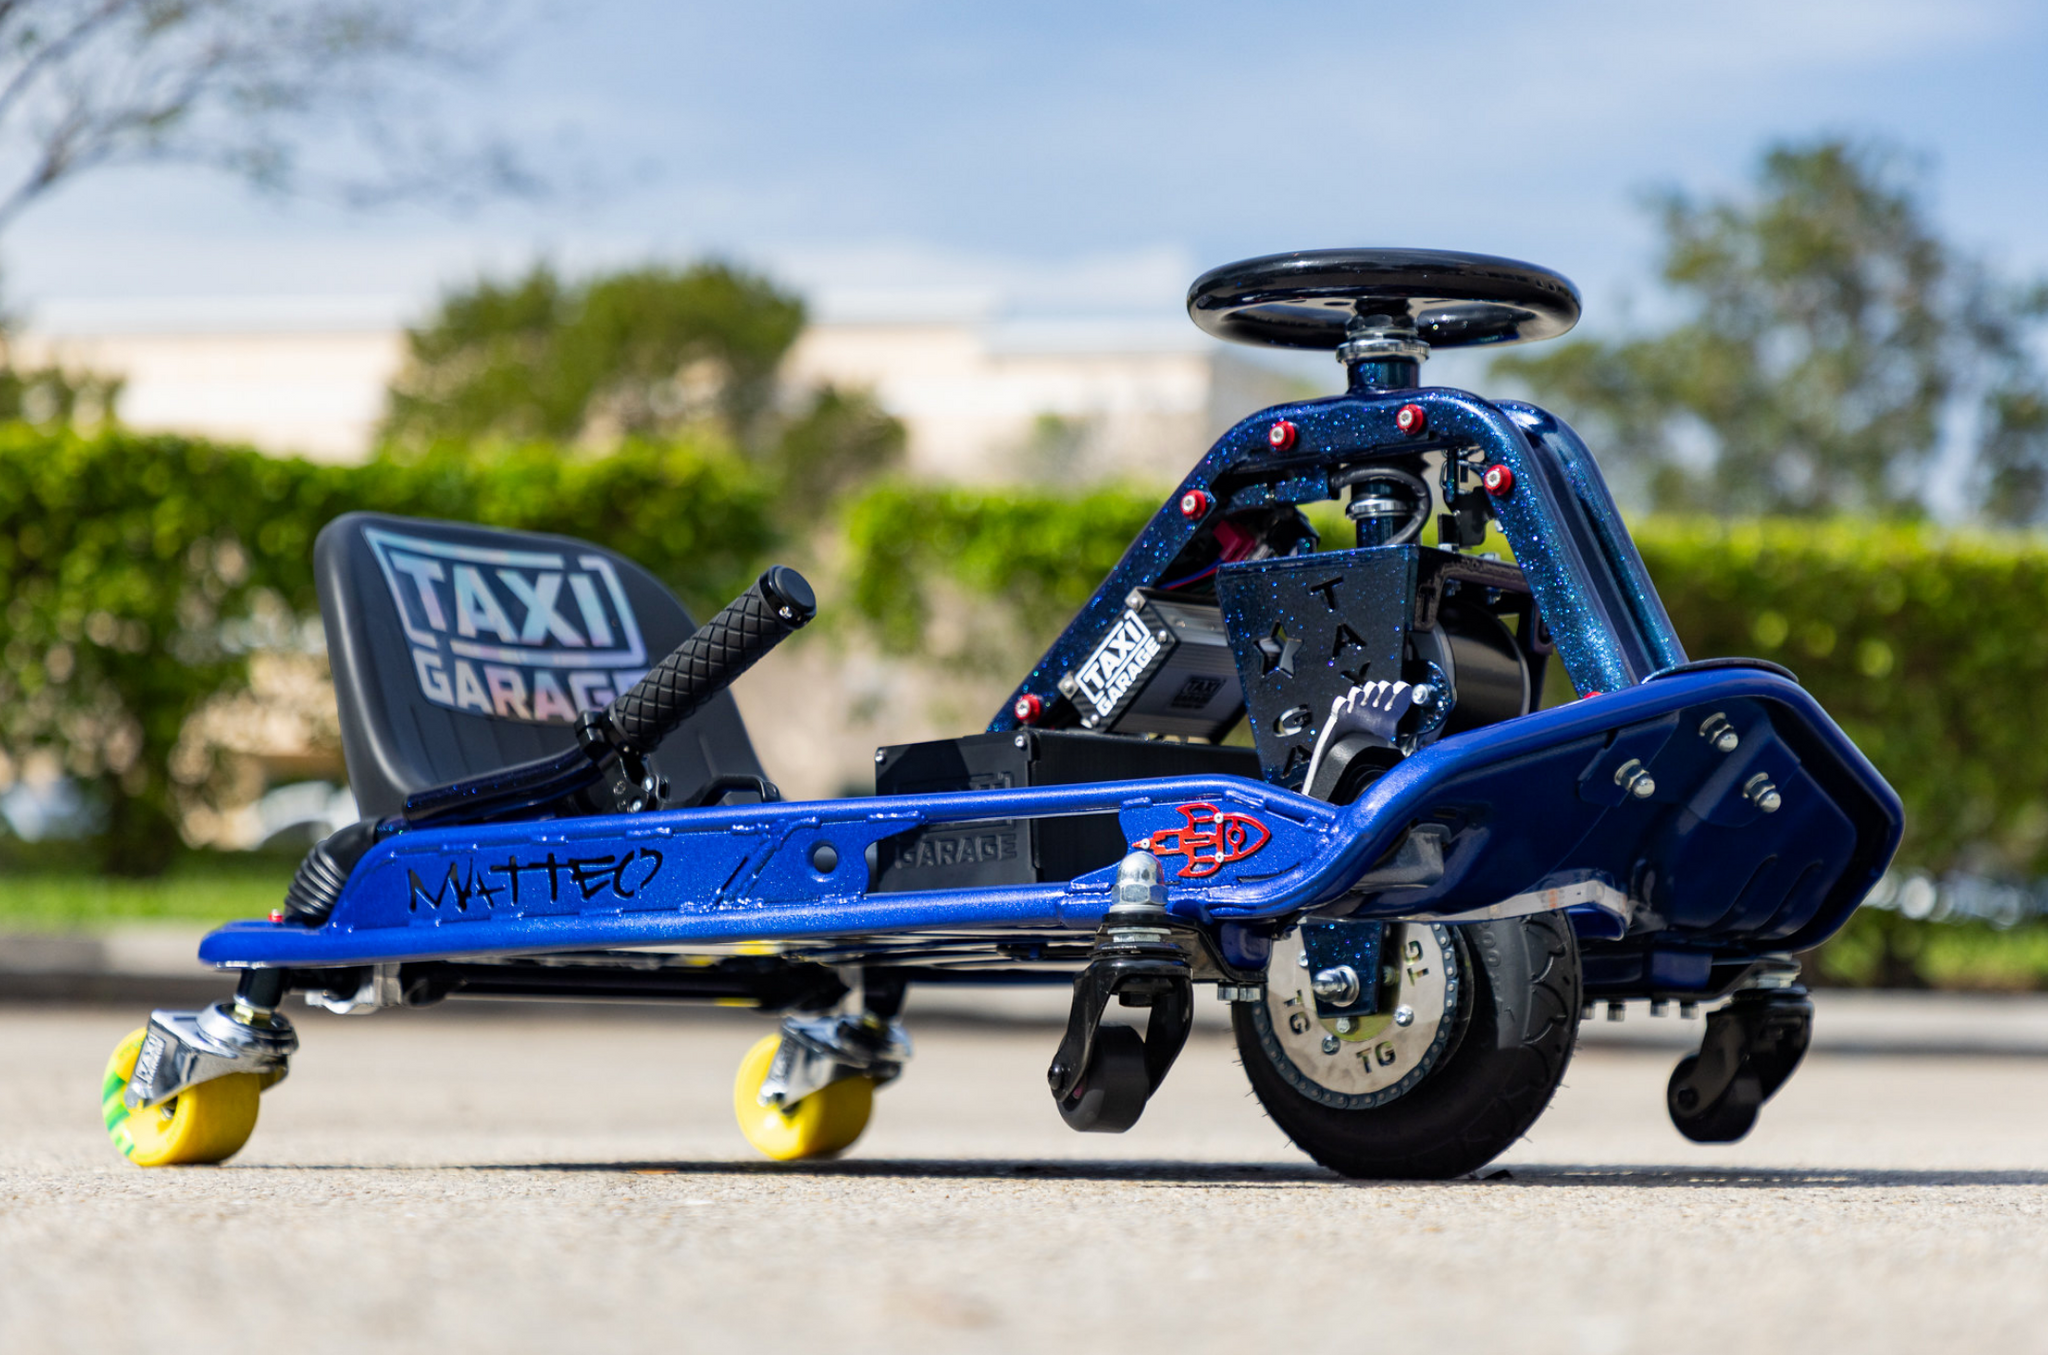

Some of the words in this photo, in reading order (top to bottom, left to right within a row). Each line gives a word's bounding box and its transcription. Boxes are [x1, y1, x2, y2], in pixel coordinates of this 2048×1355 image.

[389, 552, 615, 647] TAXI
[1083, 620, 1142, 689] TAXI
[1096, 636, 1161, 717] GARAGE
[406, 849, 664, 914] MATTEO
[1403, 940, 1430, 987] TG
[1283, 988, 1311, 1036] TG
[1355, 1040, 1397, 1074] TG
